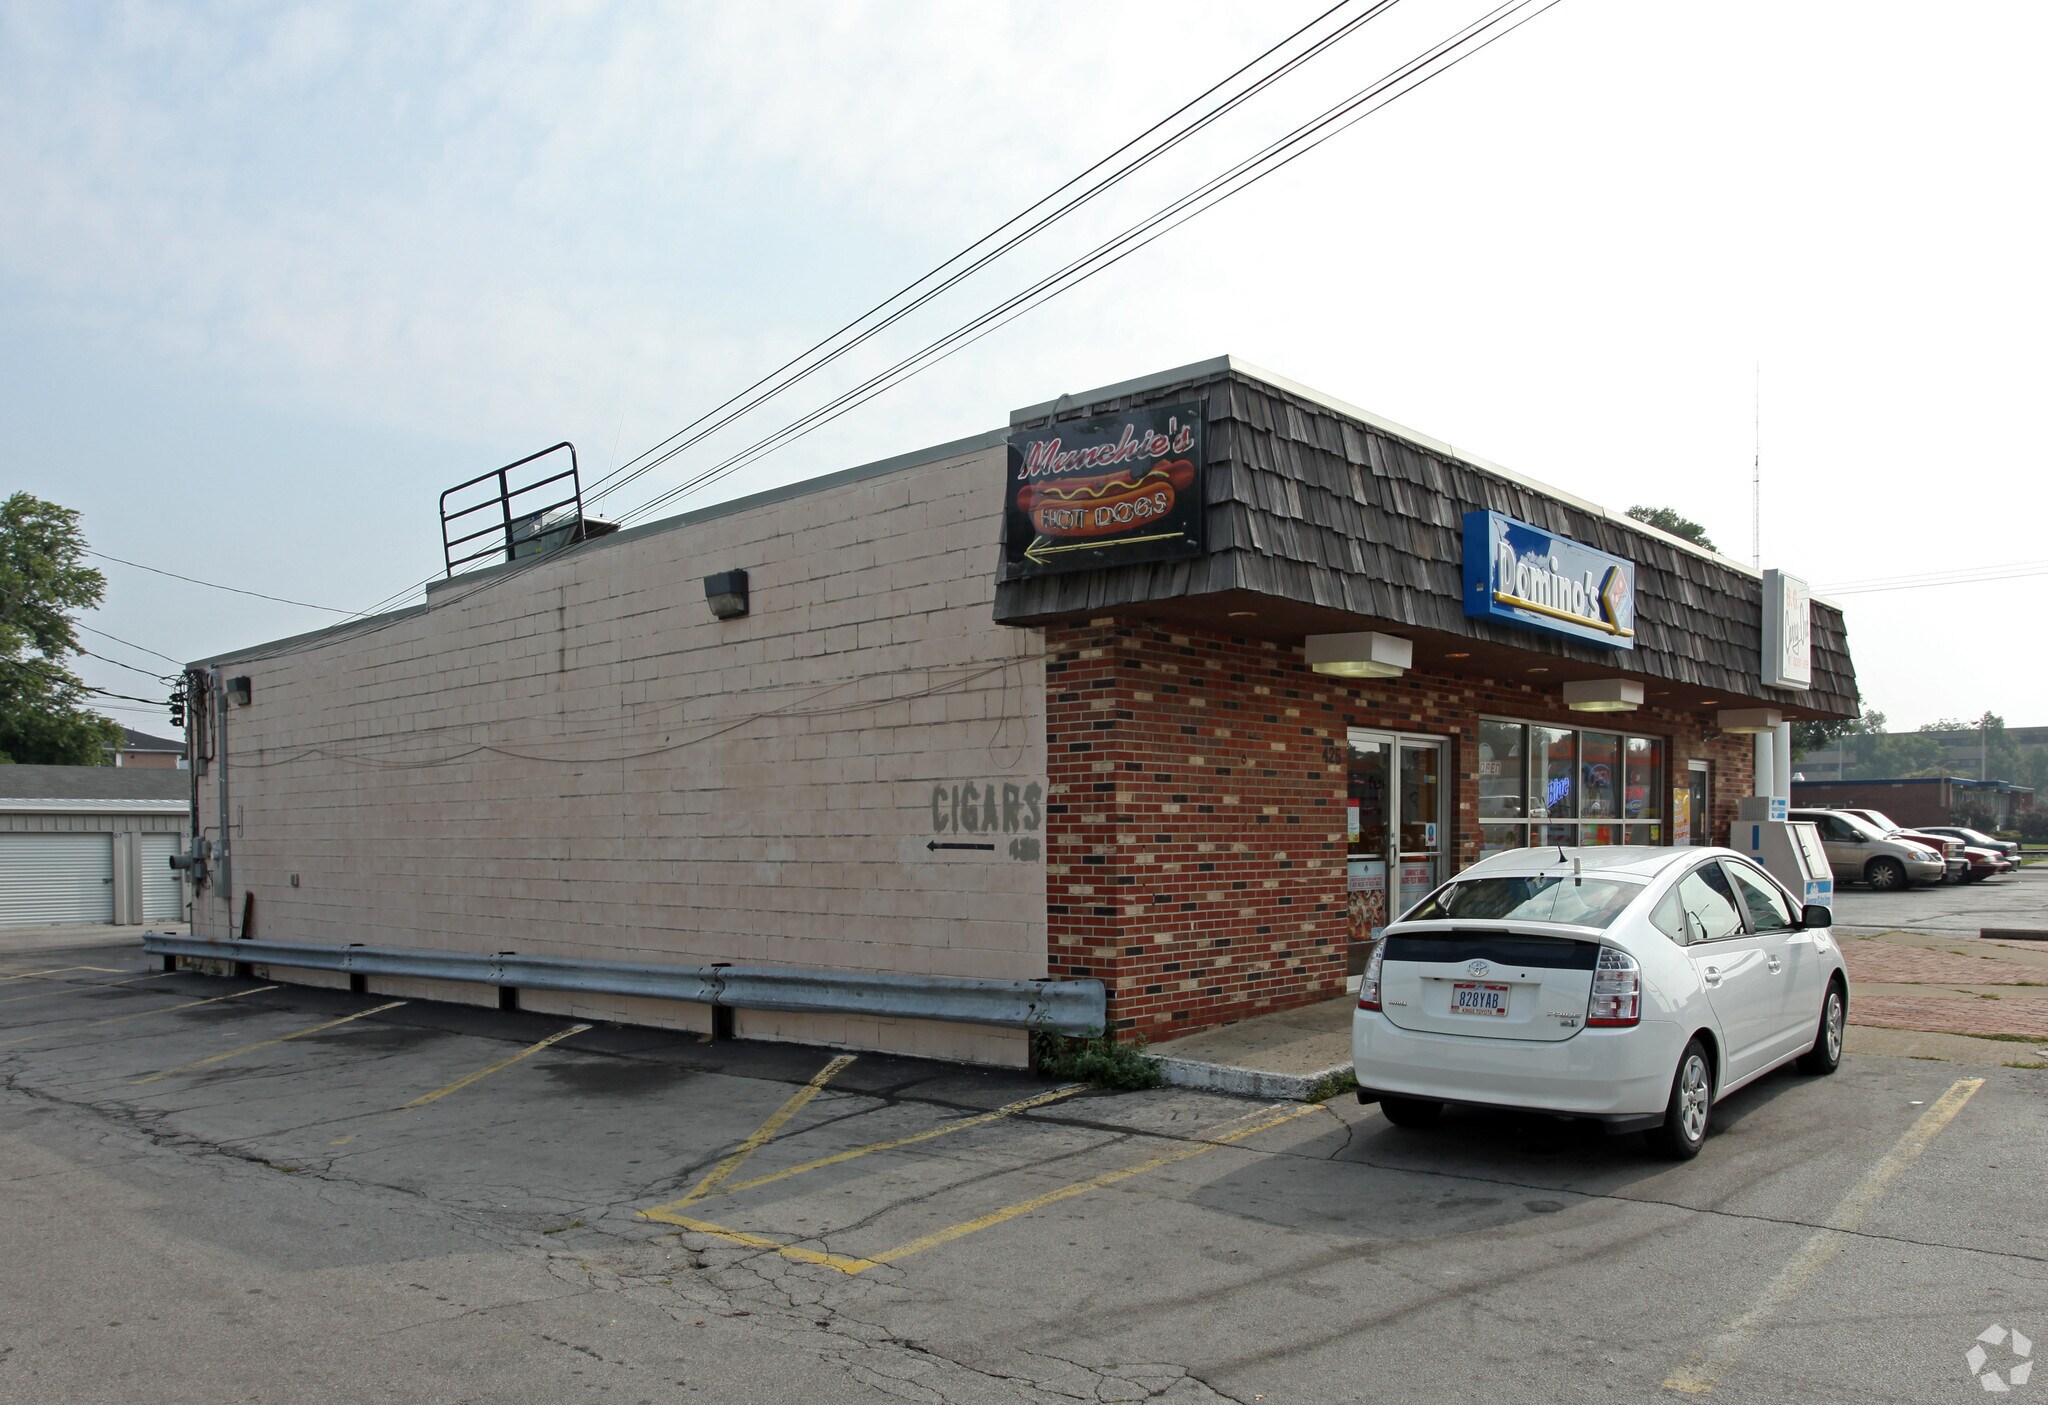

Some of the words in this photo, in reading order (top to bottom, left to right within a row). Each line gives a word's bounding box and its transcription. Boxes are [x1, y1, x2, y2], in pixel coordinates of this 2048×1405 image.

[1018, 415, 1195, 480] Munchie's
[1040, 508, 1088, 530] HOT
[1094, 492, 1168, 527] DOGS
[1498, 541, 1601, 621] Domino's
[932, 780, 1043, 834] CIGARS
[1459, 991, 1499, 1009] 828YAB
